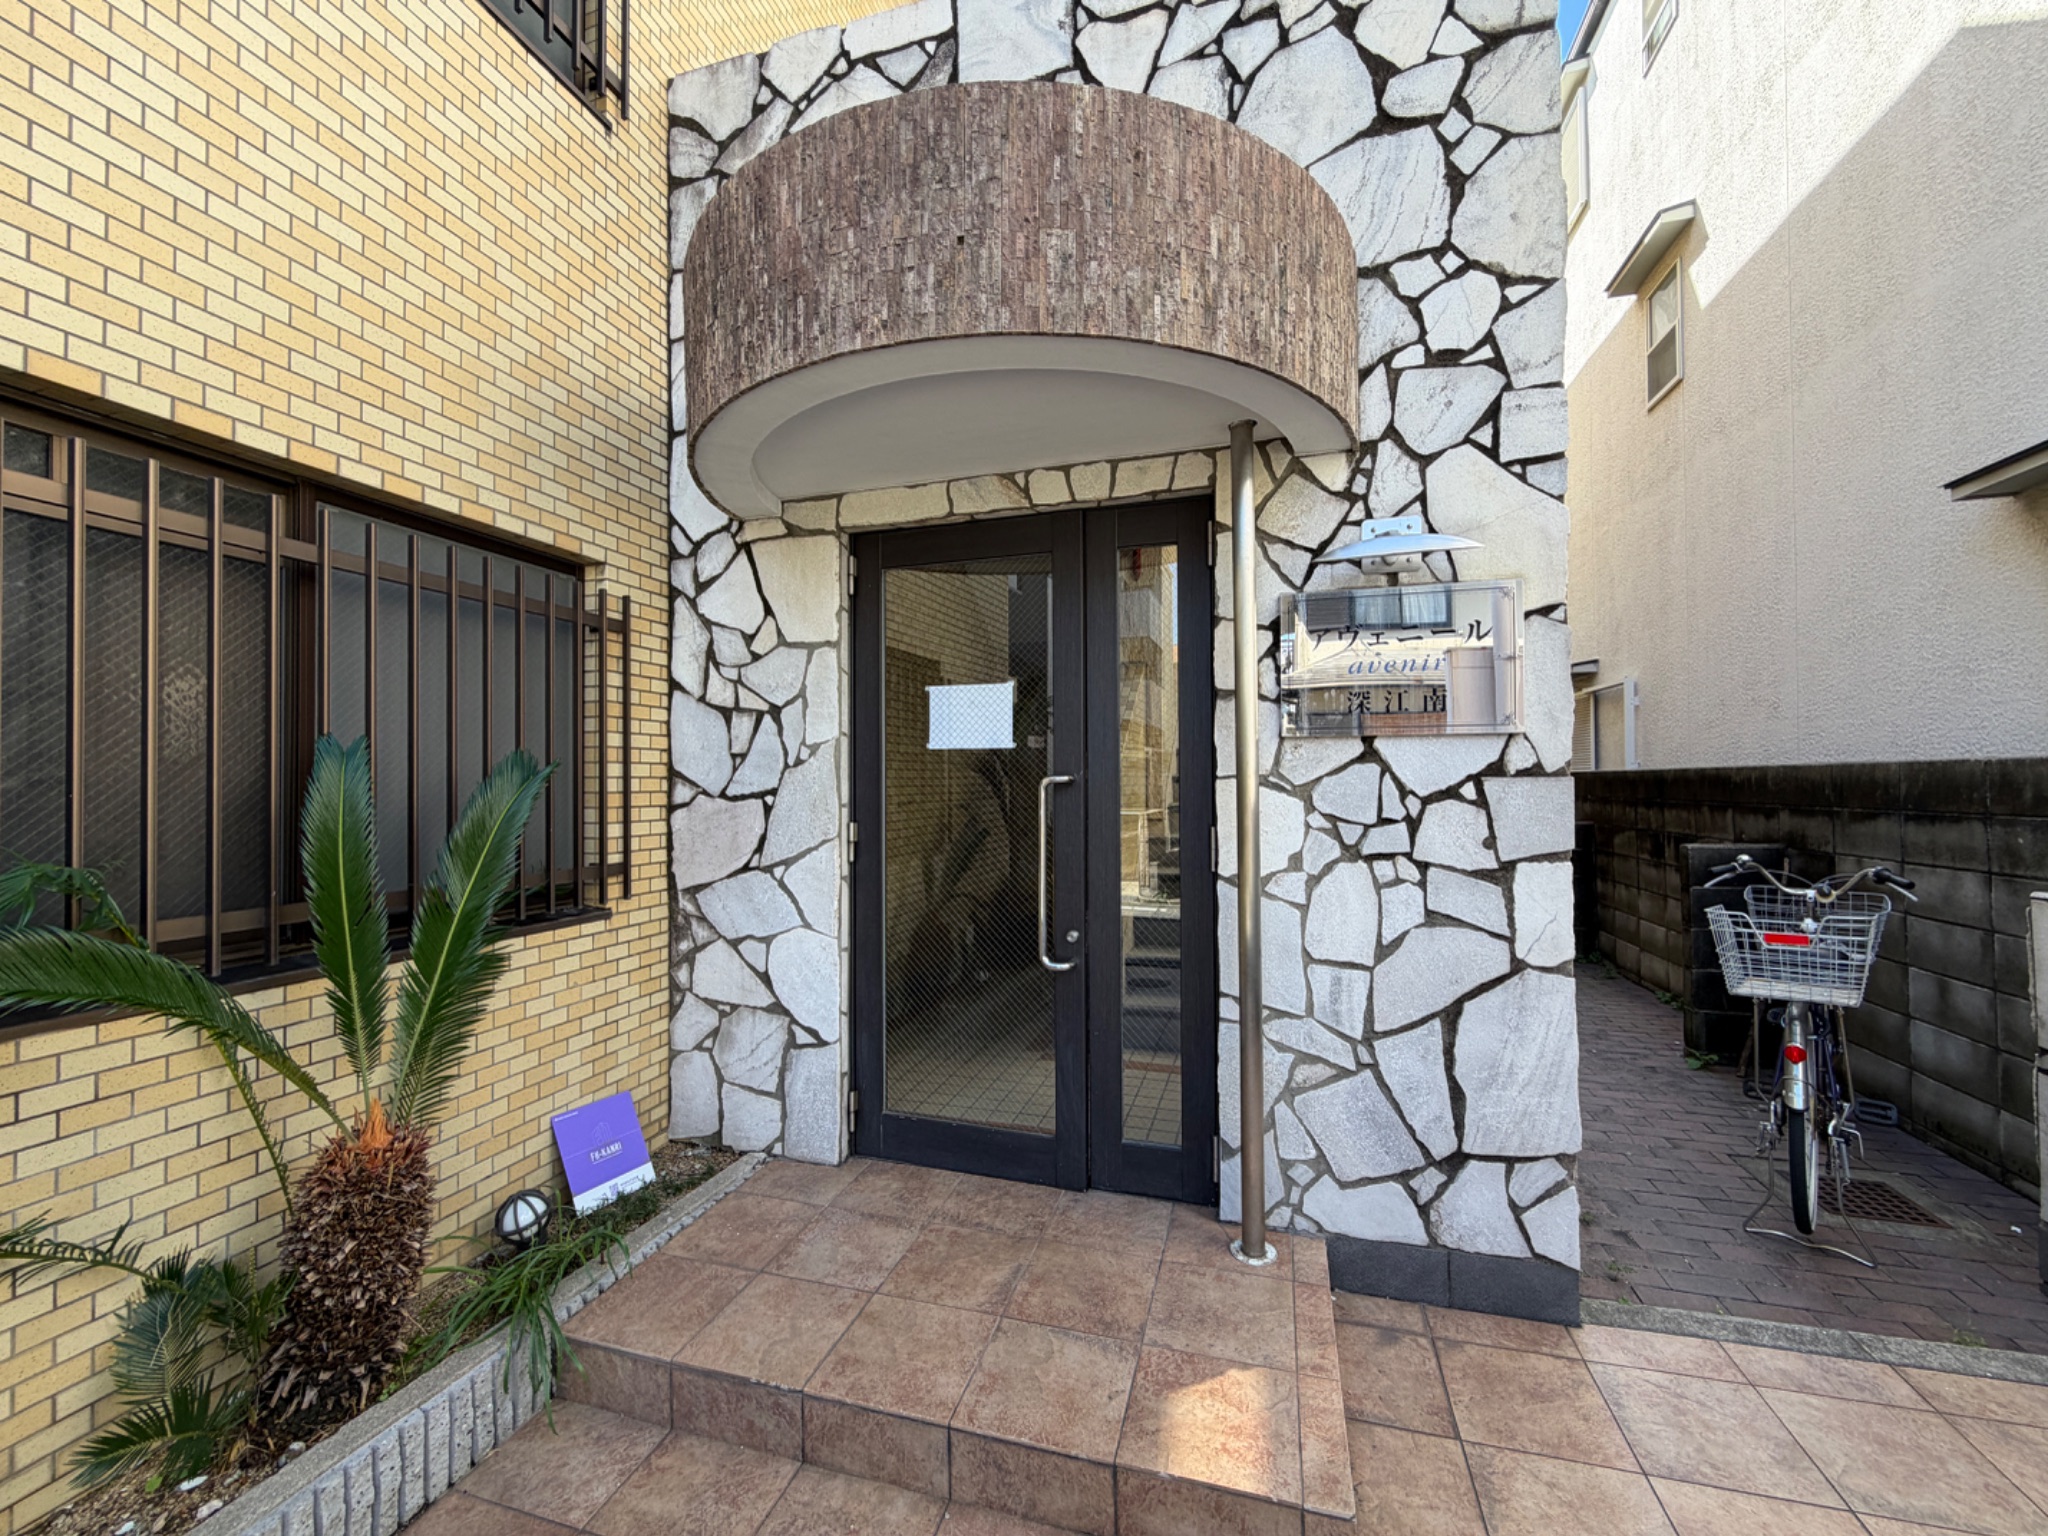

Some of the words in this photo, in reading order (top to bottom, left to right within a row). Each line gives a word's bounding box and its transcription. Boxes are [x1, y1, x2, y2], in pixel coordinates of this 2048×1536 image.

[1309, 620, 1493, 650] アヴェニール
[1348, 655, 1447, 674] avenir
[1347, 688, 1447, 713] 深江南
